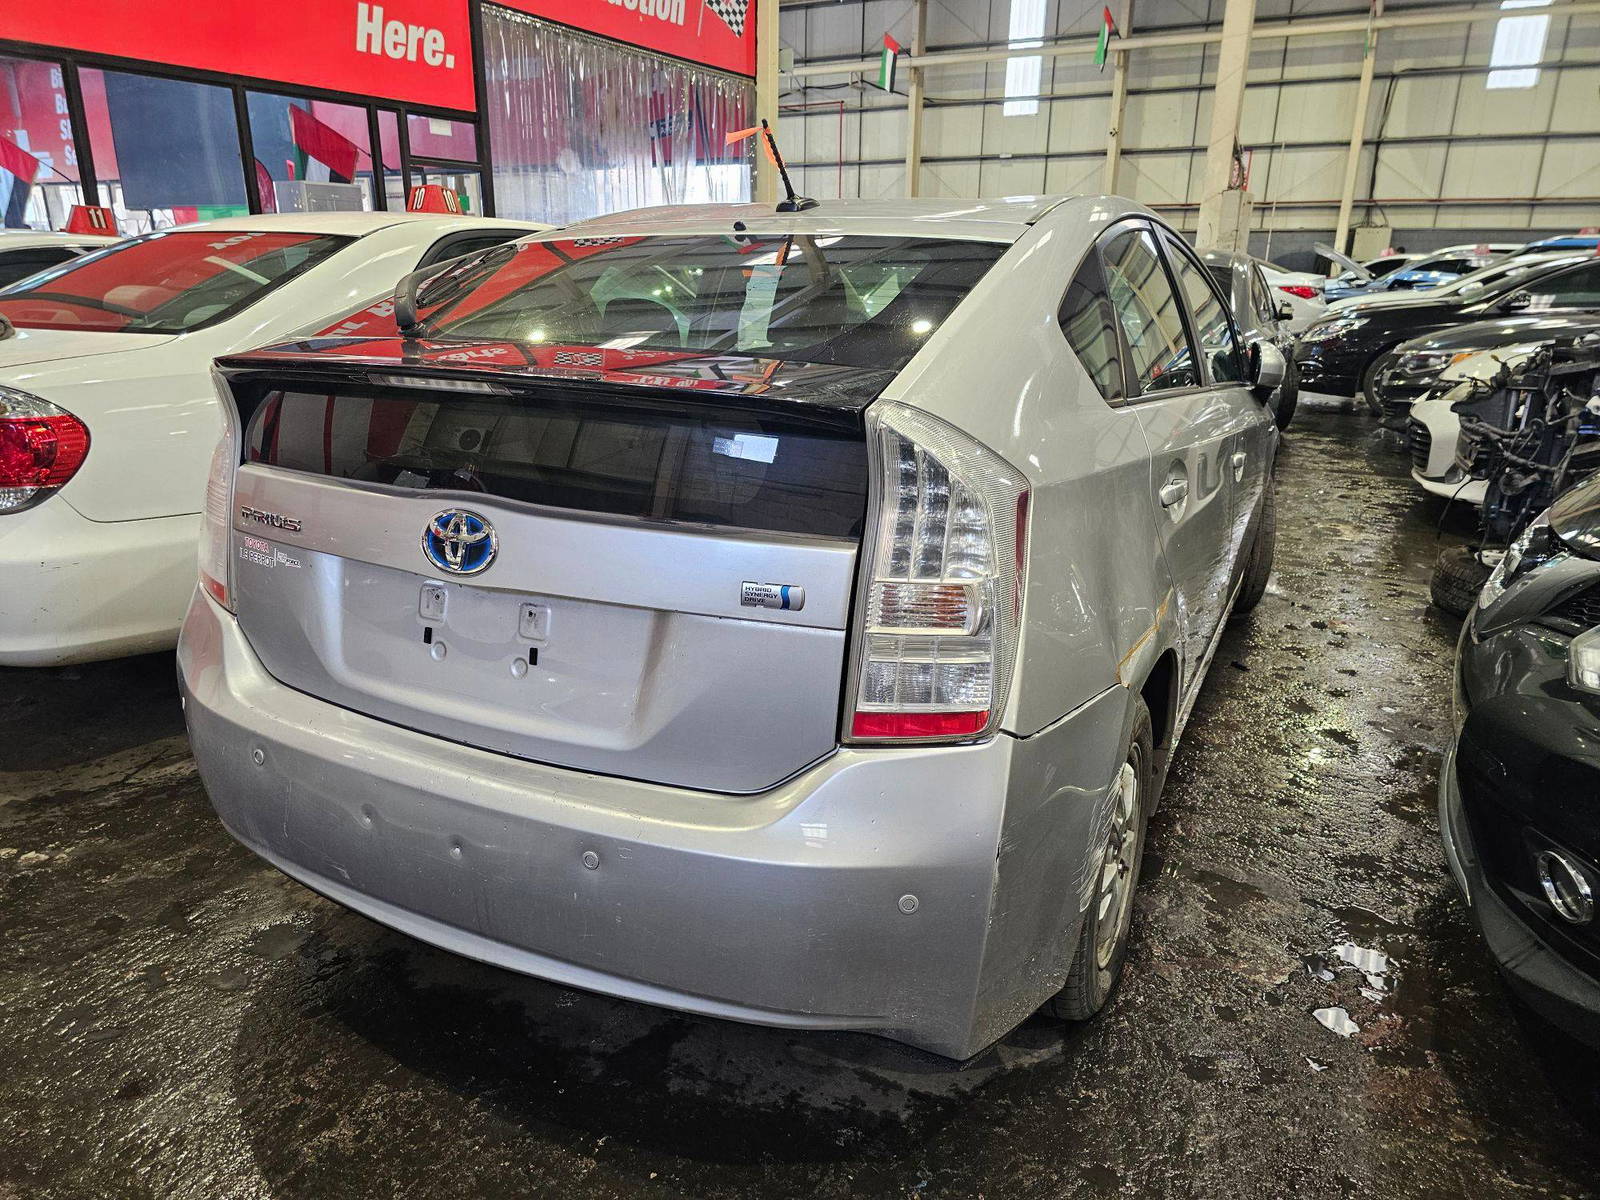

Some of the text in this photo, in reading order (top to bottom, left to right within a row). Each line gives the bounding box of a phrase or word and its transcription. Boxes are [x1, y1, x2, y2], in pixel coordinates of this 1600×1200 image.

[356, 2, 455, 69] Here.
[412, 187, 426, 211] 10
[442, 189, 457, 213] 10
[89, 208, 107, 229] 11
[241, 504, 302, 532] PRIUS
[744, 591, 778, 599] SYNERGY
